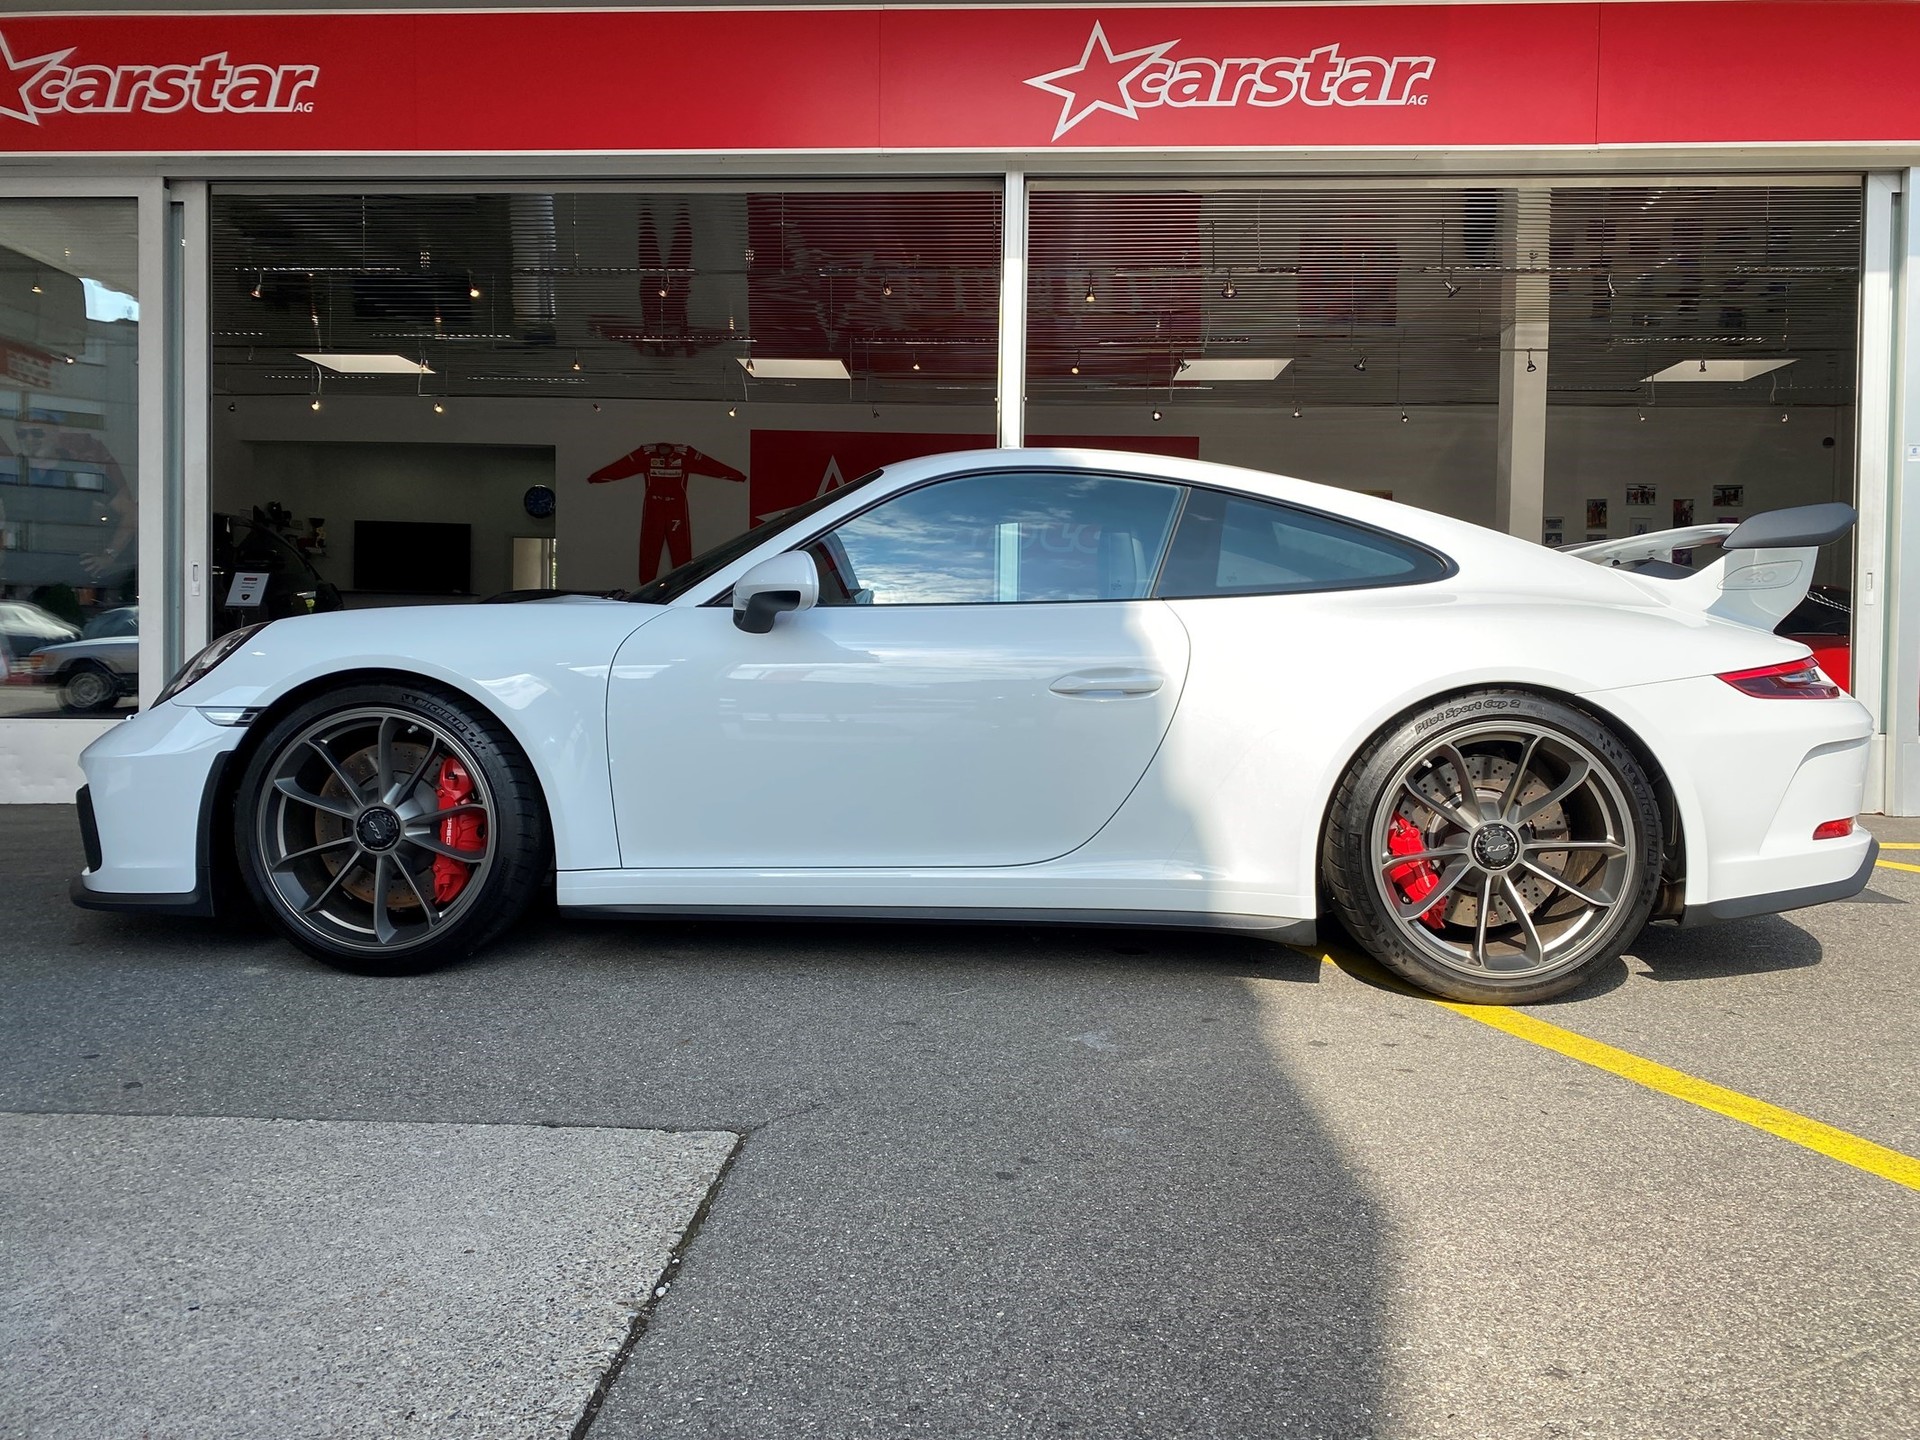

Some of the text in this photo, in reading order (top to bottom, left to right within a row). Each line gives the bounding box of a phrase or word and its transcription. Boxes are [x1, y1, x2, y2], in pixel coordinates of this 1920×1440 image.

[21, 51, 320, 113] carstar
[1119, 43, 1436, 107] carstar
[293, 102, 315, 113] AG
[1406, 94, 1429, 106] AG
[671, 519, 681, 532] 7
[415, 698, 469, 733] MICHELIN
[1414, 699, 1521, 735] Pilot Sport Cup 2
